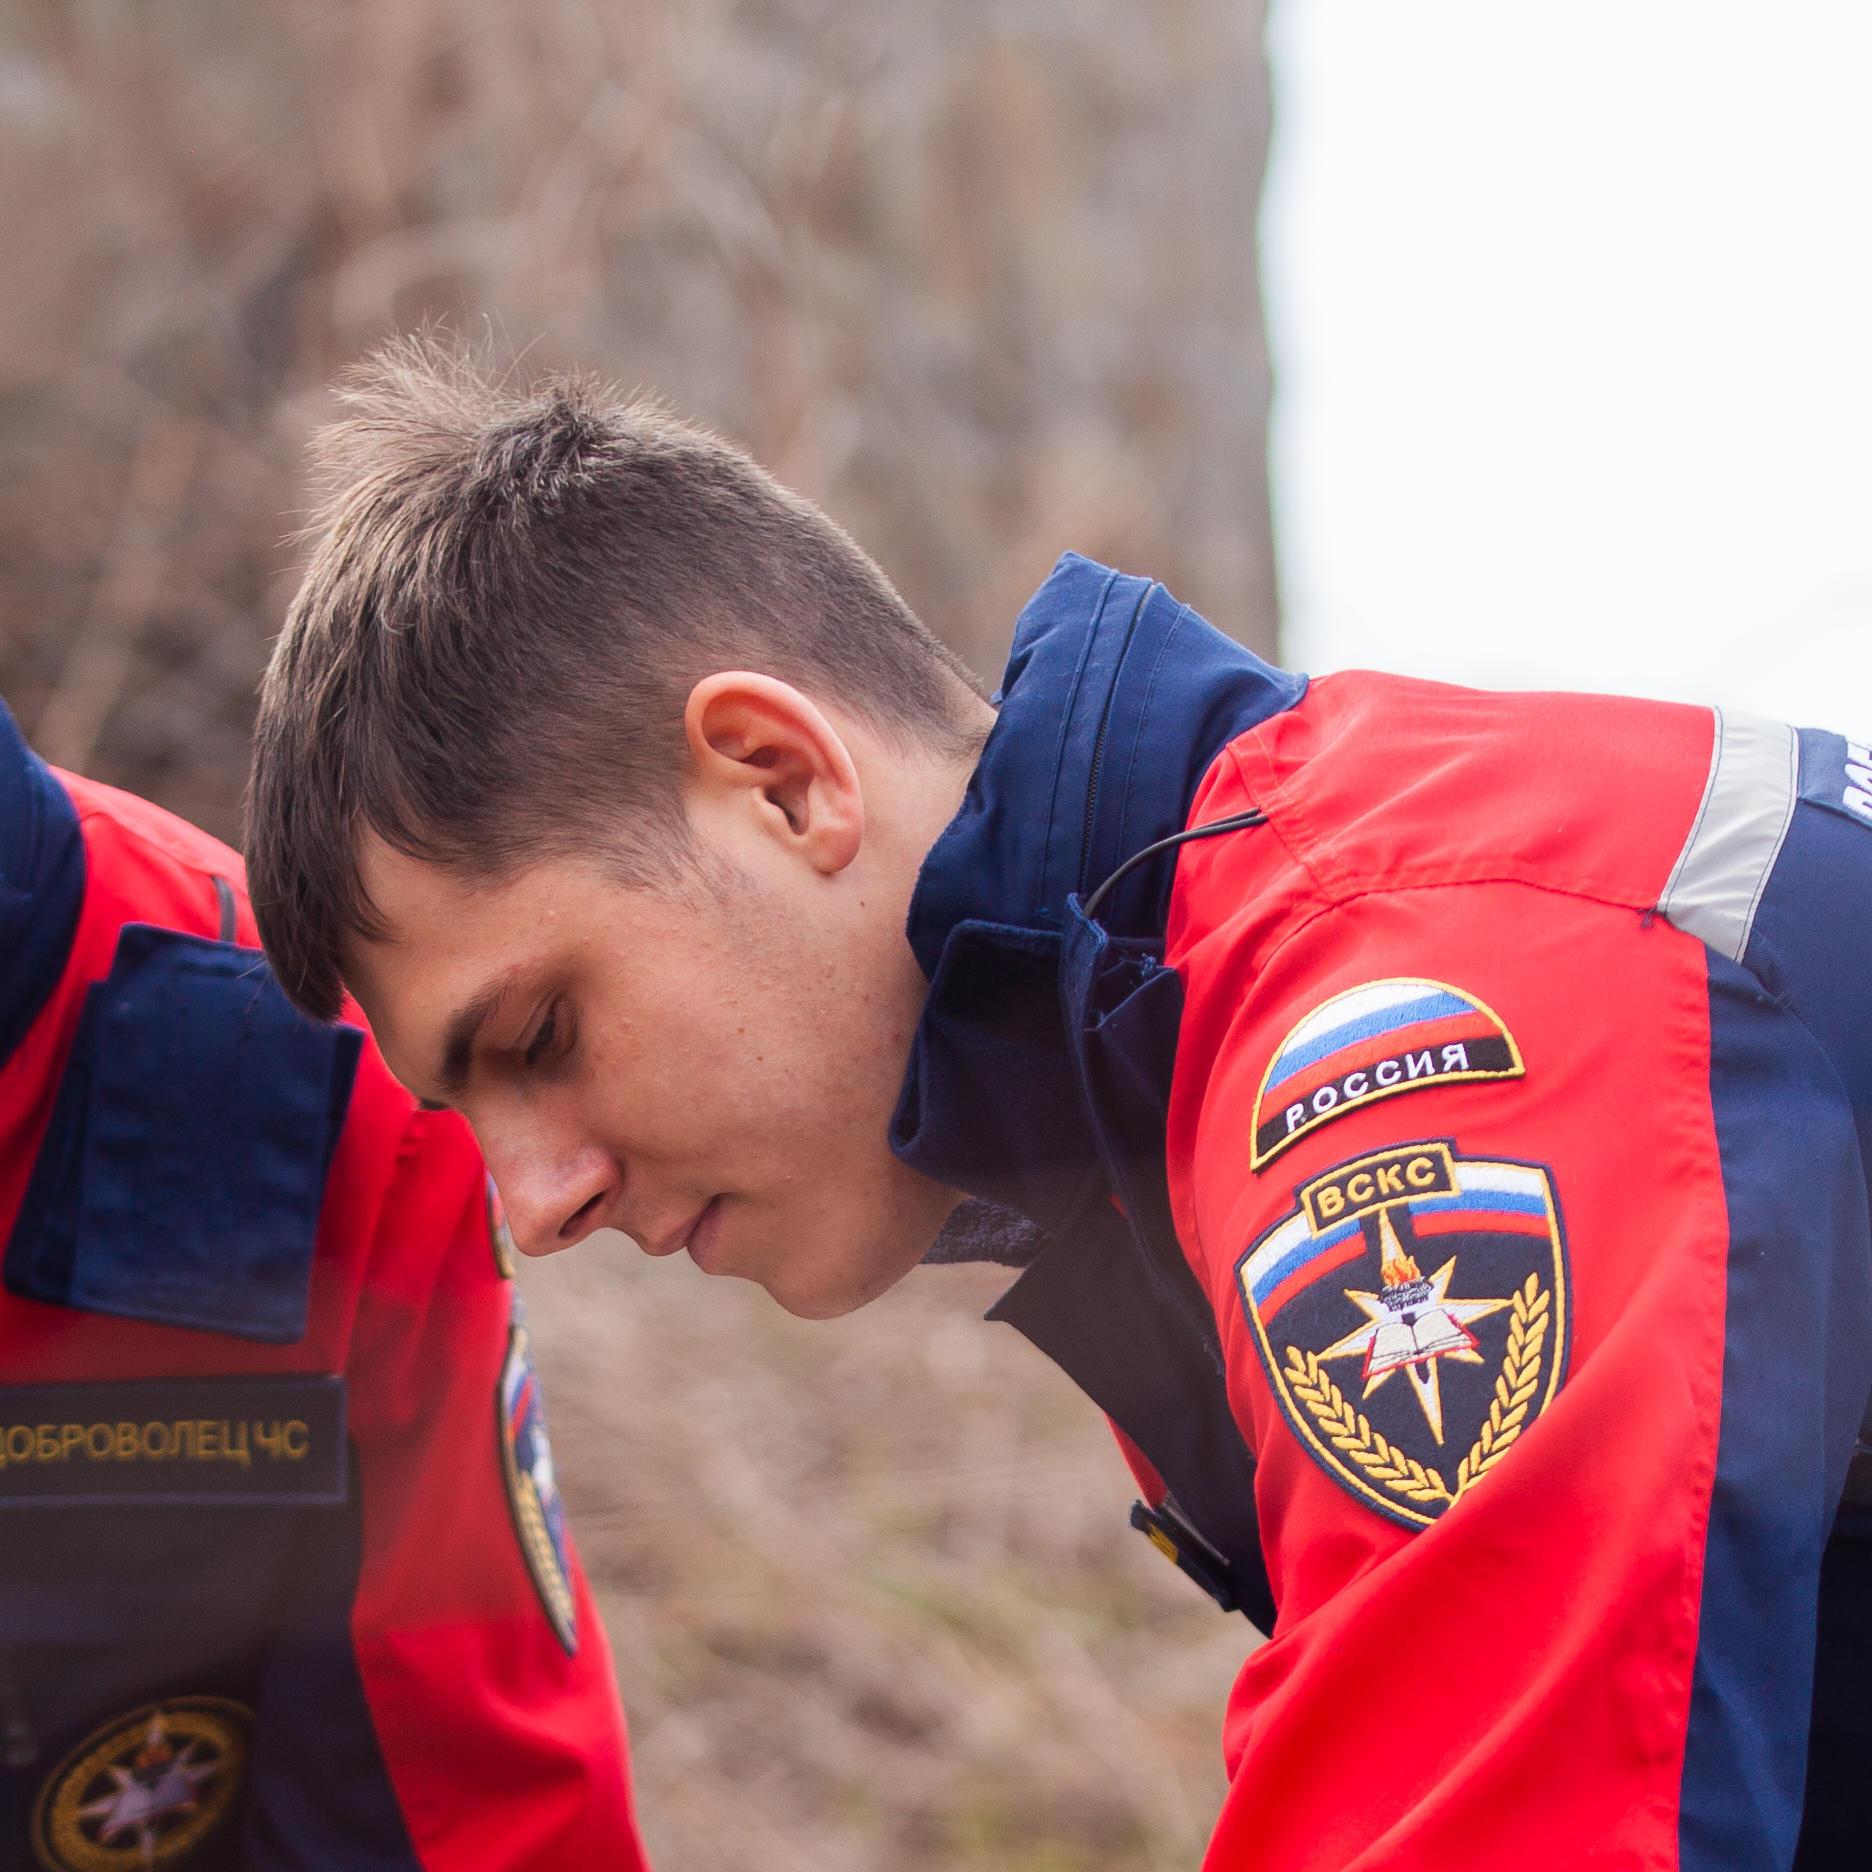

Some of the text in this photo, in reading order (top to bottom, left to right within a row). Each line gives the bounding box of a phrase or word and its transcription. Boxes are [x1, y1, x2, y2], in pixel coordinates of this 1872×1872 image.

[1282, 1042, 1471, 1134] РОССИЯ
[1317, 1156, 1437, 1219] ВСКС
[253, 1419, 311, 1461] ЧС
